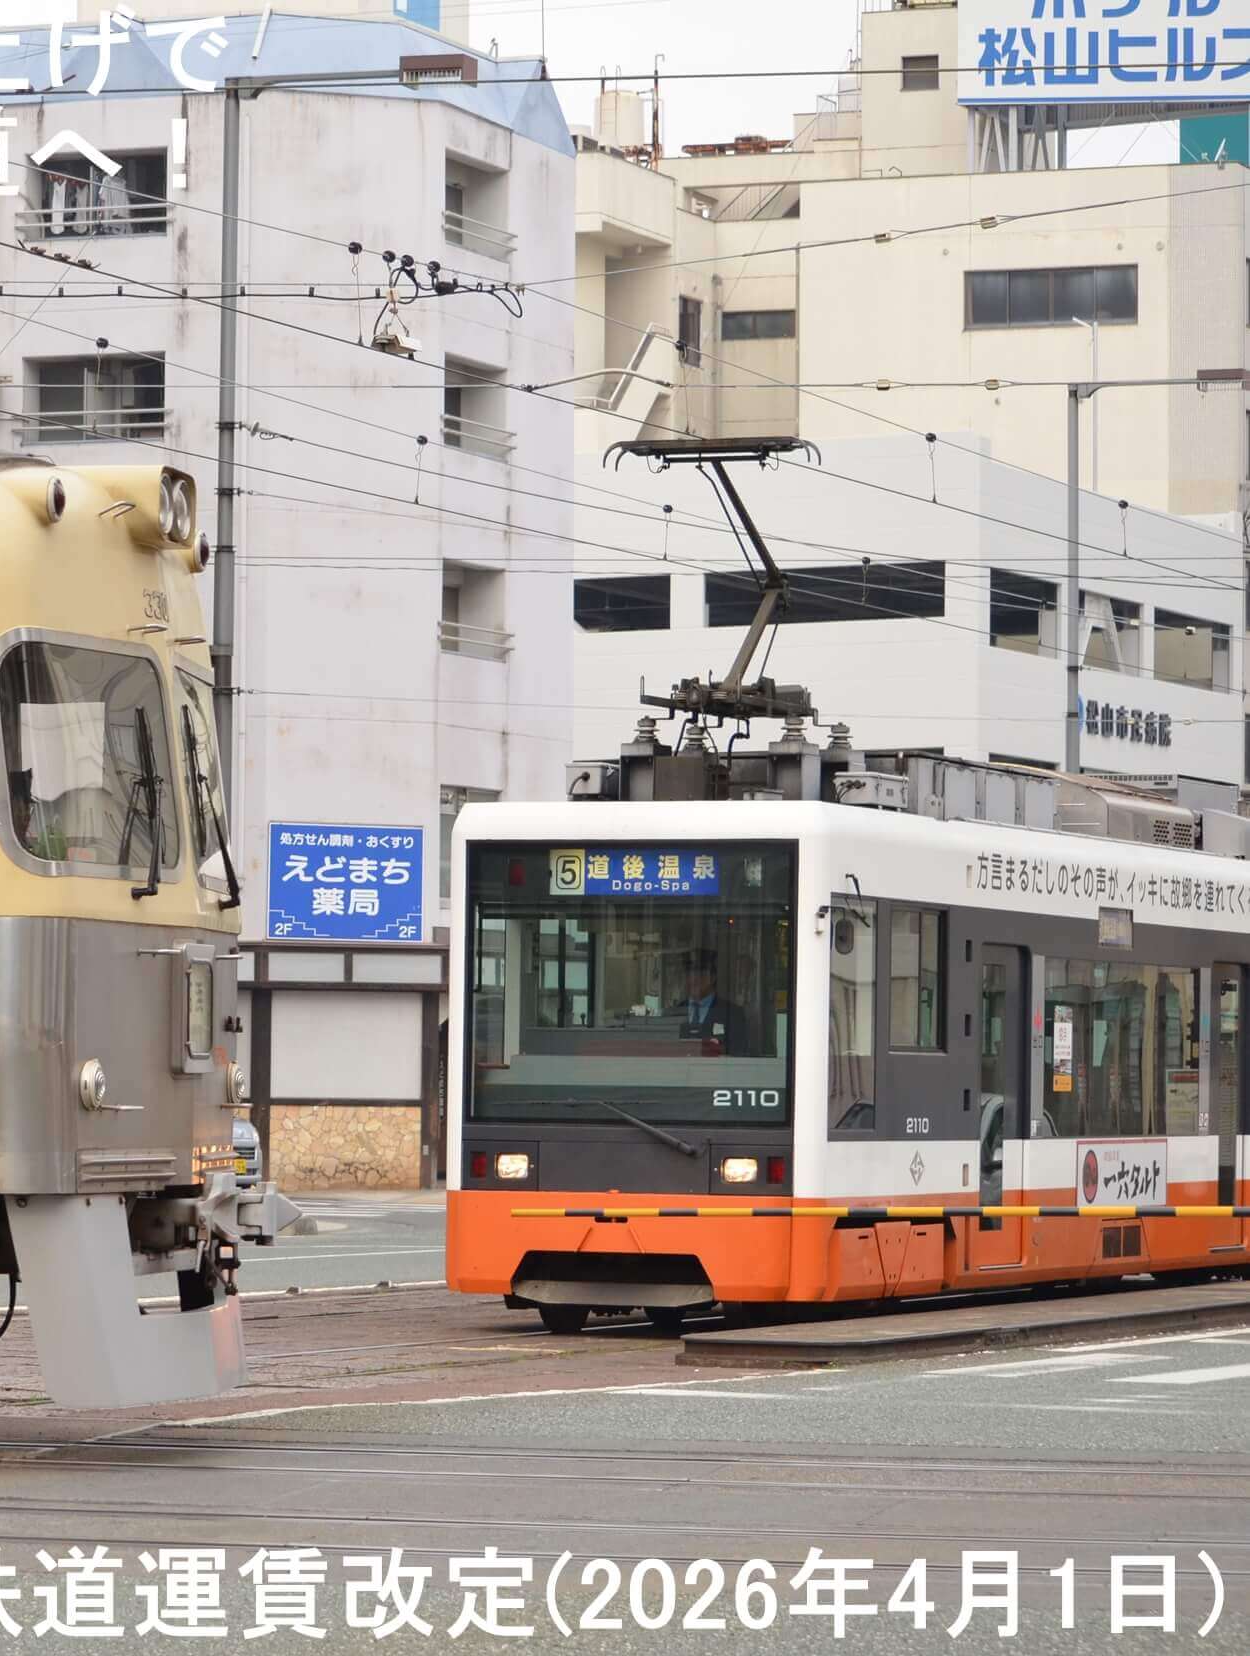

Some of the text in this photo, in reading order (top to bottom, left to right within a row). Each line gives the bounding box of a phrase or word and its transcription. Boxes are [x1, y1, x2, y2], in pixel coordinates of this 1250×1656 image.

[282, 854, 412, 885] えどまち
[560, 854, 716, 886] 5 道後温泉
[612, 880, 690, 891] Dogo-Spa
[976, 852, 1250, 914] 方言まるだしのその声が、イッキに故郷を連れてく
[311, 887, 380, 916] 薬局
[274, 922, 294, 936] 2F
[398, 925, 417, 938] 2F
[713, 1090, 779, 1107] 2110
[906, 1117, 929, 1134] 2110
